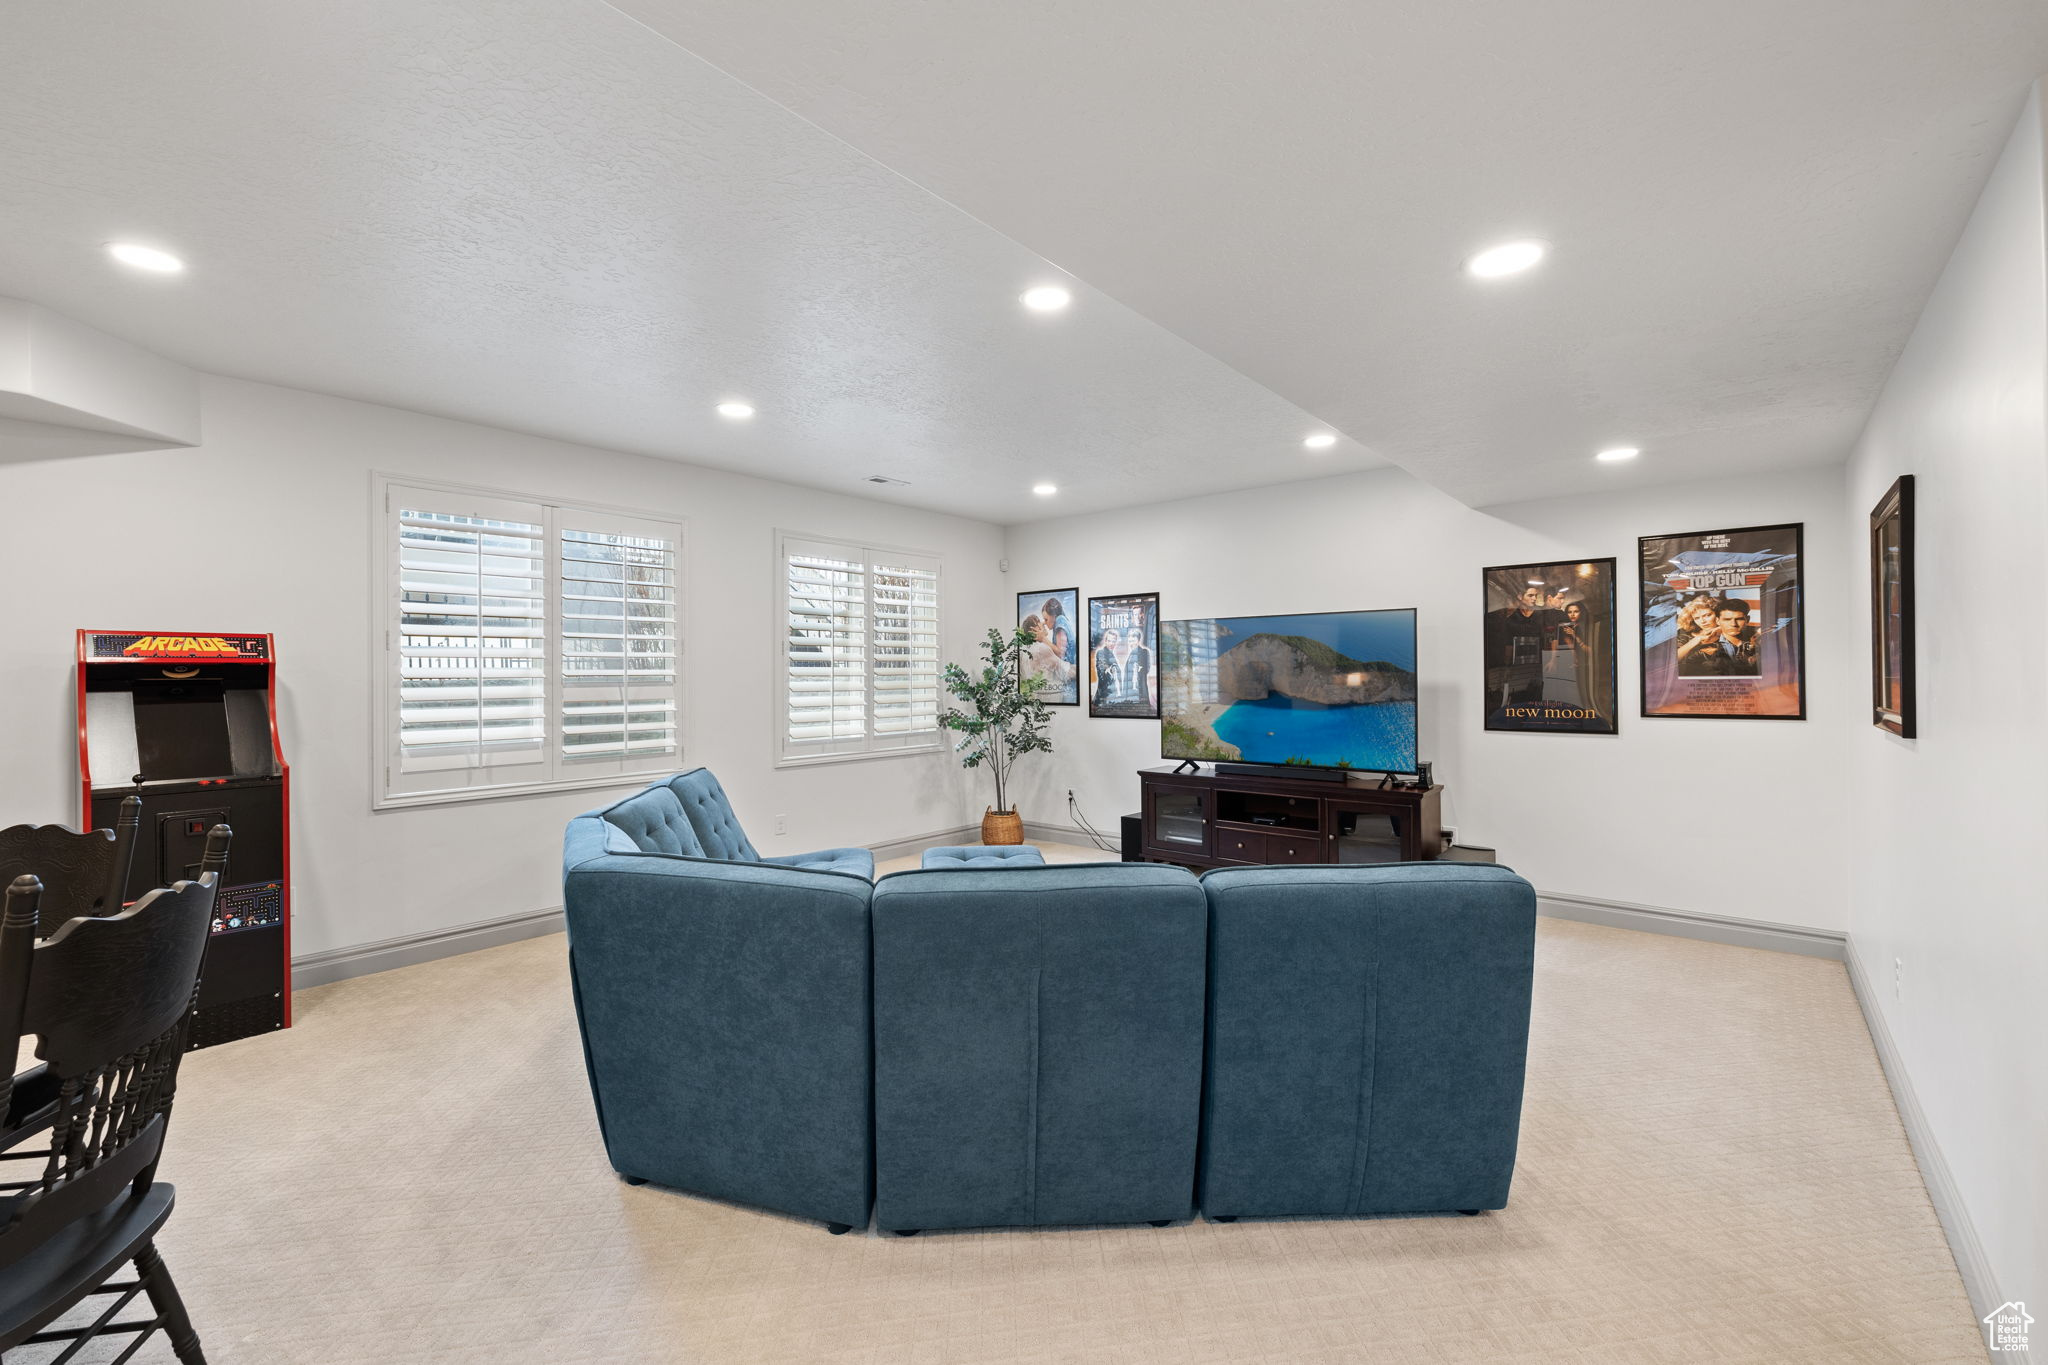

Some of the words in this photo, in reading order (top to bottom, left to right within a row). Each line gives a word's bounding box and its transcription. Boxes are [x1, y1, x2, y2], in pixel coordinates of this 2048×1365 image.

[1689, 575, 1714, 589] TOP
[1716, 573, 1746, 587] GUN
[1100, 613, 1129, 629] SAINTS
[123, 636, 239, 656] ARCADE
[1505, 708, 1540, 718] new
[1545, 708, 1596, 719] moon
